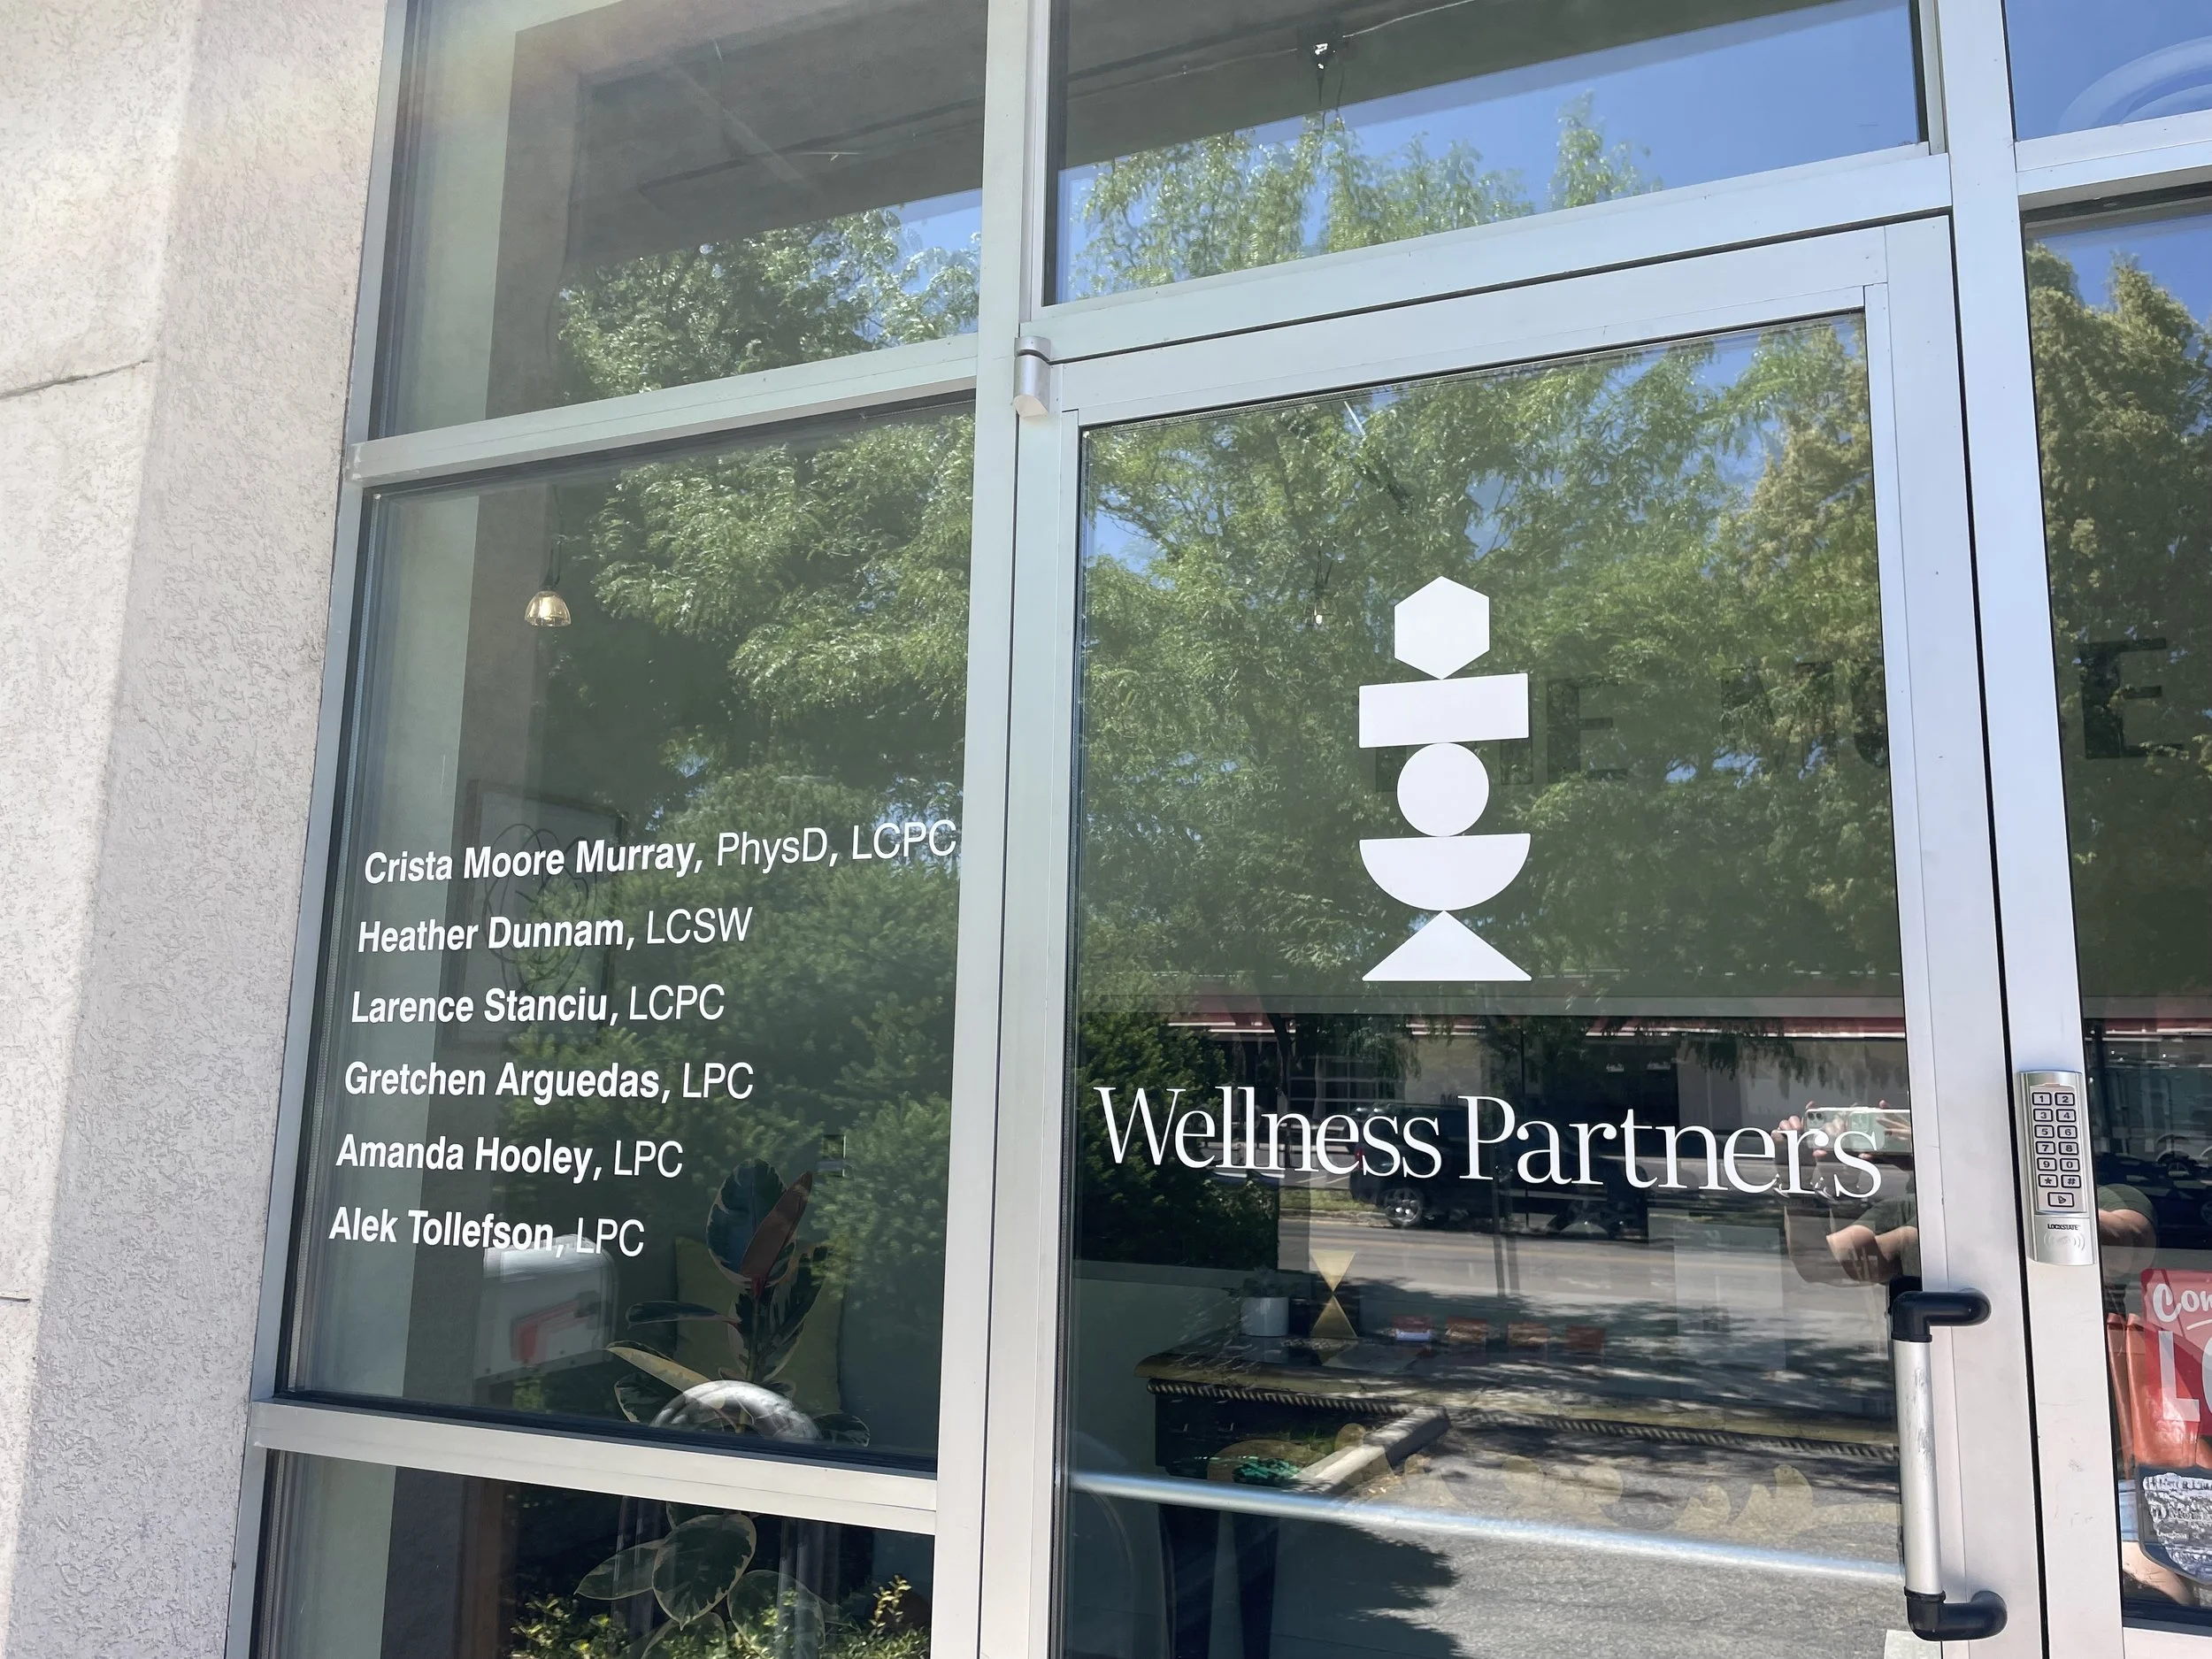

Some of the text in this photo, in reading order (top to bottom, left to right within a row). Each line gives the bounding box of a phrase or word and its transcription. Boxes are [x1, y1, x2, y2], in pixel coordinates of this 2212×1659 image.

[365, 818, 957, 884] Crista Moore Murray, PhysD, LCPC
[357, 906, 754, 953] Heather Dunnam, LCSW
[351, 983, 726, 1026] Larence Stanciu, LCPC
[344, 1061, 755, 1106] Gretchen Arguedas, LPC
[335, 1133, 684, 1185] Amanda Hooley, LPC
[1093, 1086, 1883, 1199] Wellness Partners
[328, 1206, 646, 1258] Alek Tollefson, LPC
[2158, 1330, 2212, 1422] L
